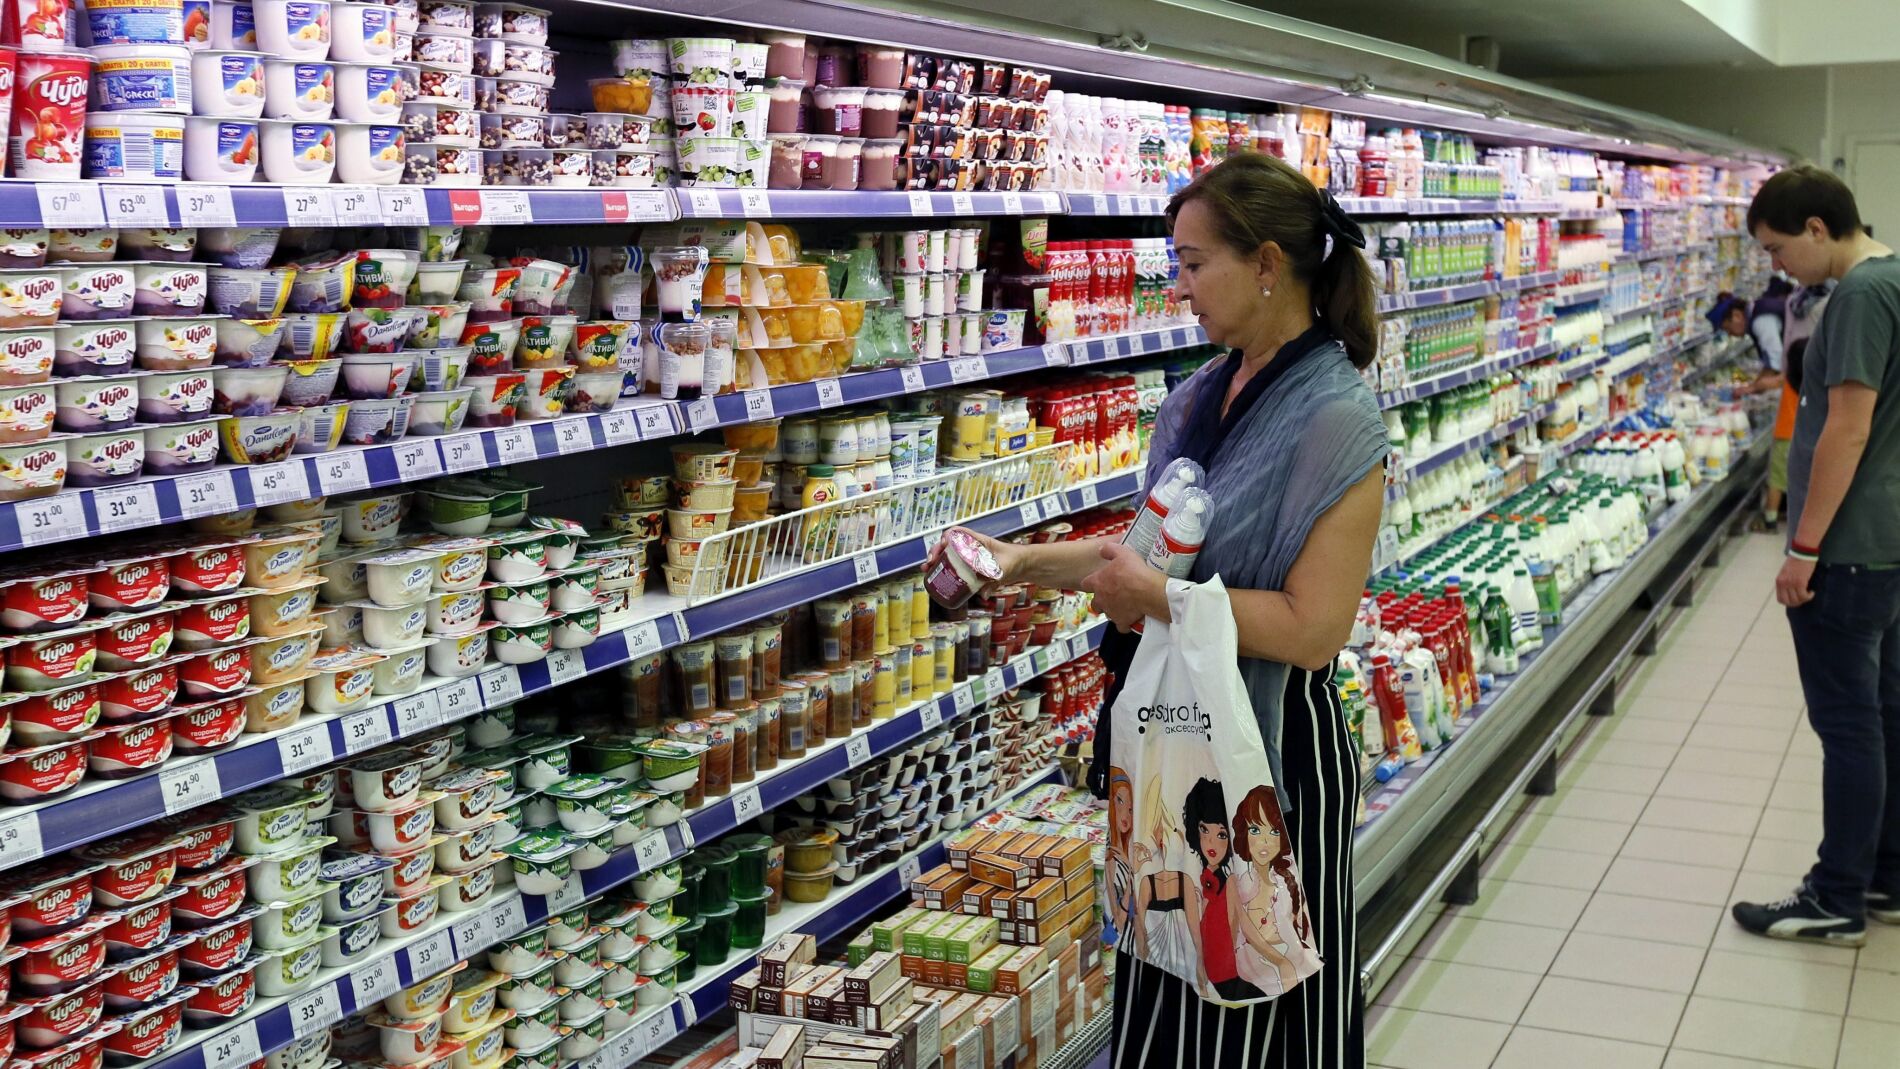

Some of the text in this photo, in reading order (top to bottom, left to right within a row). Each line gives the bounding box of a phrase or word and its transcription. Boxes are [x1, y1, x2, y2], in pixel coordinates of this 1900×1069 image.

[40, 75, 88, 107] Чудо
[296, 196, 317, 212] 27.90
[346, 194, 364, 211] 27.90
[393, 197, 412, 212] 27.90
[24, 279, 55, 299] Чудо
[92, 274, 124, 292] Чудо
[172, 273, 199, 291] Чудо
[96, 327, 127, 349] Чудо
[186, 324, 212, 344] Чудо
[7, 337, 42, 358] Чудо
[585, 343, 617, 353] АКТИВИ
[99, 384, 129, 407] Чудо
[181, 378, 207, 397] Чудо
[14, 392, 46, 414] Чудо
[610, 419, 624, 433] 28.90
[646, 414, 659, 427] 28.90
[187, 428, 213, 448] Чудо
[505, 435, 522, 451] 37.00
[563, 426, 578, 441] 28.90
[105, 439, 135, 460] Чудо
[405, 448, 424, 466] 37.00
[452, 443, 470, 459] 37.00
[24, 451, 56, 472] Чудо
[330, 461, 350, 478] 45.00
[263, 471, 285, 489] 45.00
[191, 482, 215, 502] 31.00
[34, 505, 62, 527] 31.00
[111, 496, 137, 516] 31.00
[198, 552, 228, 571] Чудо
[117, 566, 149, 587] Чудо
[39, 581, 72, 601] Чудо
[210, 604, 237, 621] Чудо
[117, 622, 150, 642] Чудо
[39, 642, 74, 662] Чудо
[214, 652, 240, 671] Чудо
[555, 655, 570, 671] 26.90
[133, 672, 162, 693] Чудо
[490, 675, 508, 692] 33.00
[53, 691, 85, 711] Чудо
[448, 688, 466, 706] 33.00
[191, 708, 222, 728] Чудо
[406, 701, 425, 720] 31.00
[124, 726, 154, 747] Чудо
[353, 718, 374, 737] 33.00
[291, 736, 312, 757] 31.00
[32, 751, 67, 772] Чудо
[174, 773, 200, 797] 24.90
[118, 861, 152, 881] Чудо
[202, 878, 230, 899] Чудо
[37, 888, 71, 911] Чудо
[131, 907, 160, 929] Чудо
[495, 908, 512, 927] 33.00
[206, 929, 235, 950] Чудо
[462, 921, 481, 942] 33.00
[57, 944, 89, 966] Чудо
[419, 942, 438, 964] 33.00
[129, 960, 160, 982] Чудо
[362, 969, 382, 991] 33.00
[218, 976, 243, 996] Чудо
[50, 997, 83, 1021] Чудо
[301, 997, 324, 1021] 33.00
[132, 1016, 163, 1037] Чудо
[216, 1035, 241, 1061] 24.90
